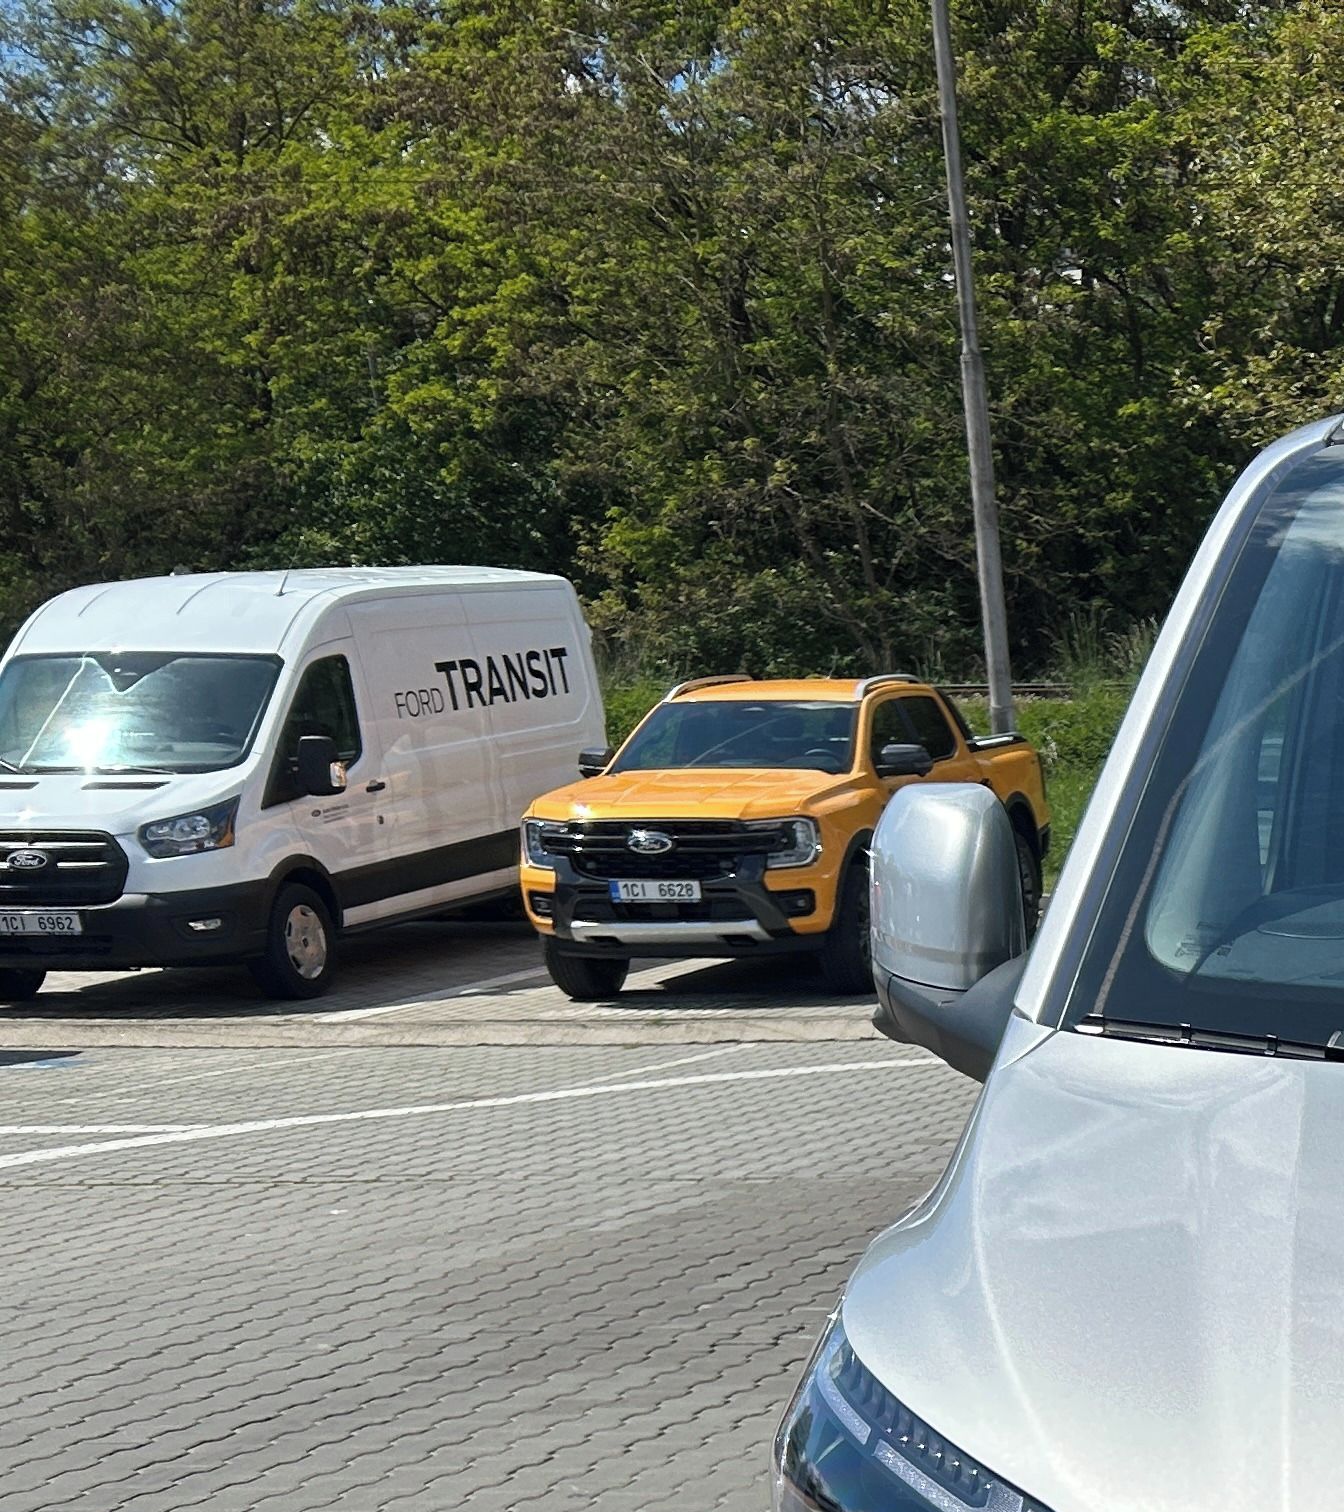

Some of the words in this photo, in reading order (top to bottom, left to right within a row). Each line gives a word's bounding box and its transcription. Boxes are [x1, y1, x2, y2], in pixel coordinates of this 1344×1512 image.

[394, 687, 445, 719] FORD
[434, 647, 571, 710] TRANSIT
[657, 883, 694, 897] 6628
[38, 916, 75, 931] 6962
